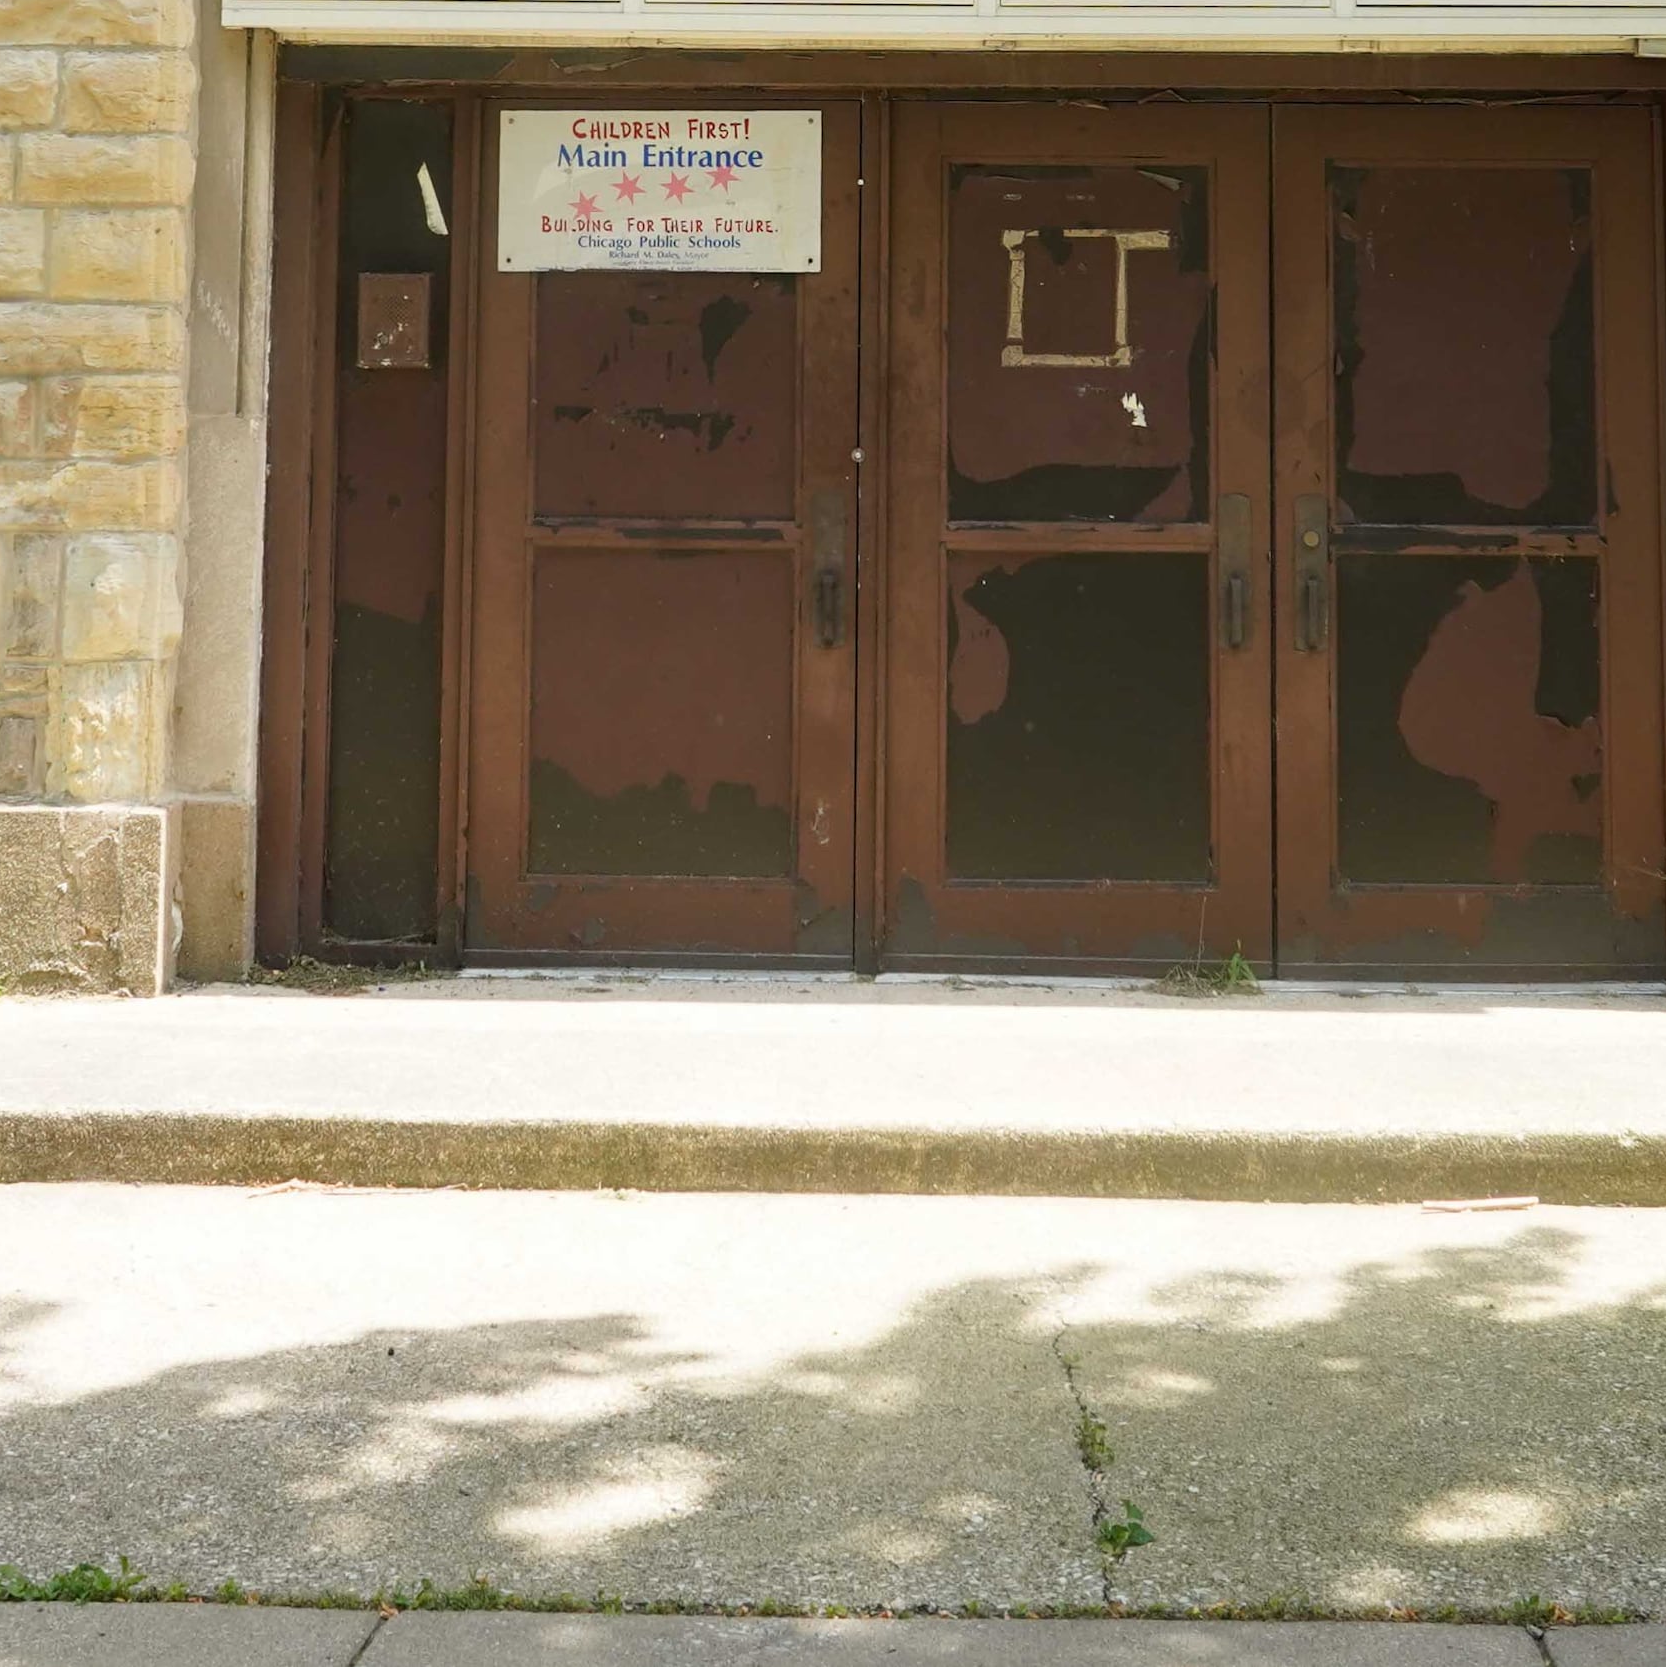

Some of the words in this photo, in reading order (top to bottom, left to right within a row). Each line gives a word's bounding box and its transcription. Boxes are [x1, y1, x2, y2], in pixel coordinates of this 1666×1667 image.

[572, 118, 670, 140] CHILDREN
[687, 118, 750, 140] FIRST!
[557, 142, 627, 167] Main
[642, 144, 763, 168] Entrance
[627, 217, 655, 233] FOR
[661, 217, 704, 234] THEIR
[715, 217, 779, 234] FUTURE.
[577, 235, 633, 252] Chicago
[639, 235, 680, 248] Public
[688, 235, 742, 249] Schools
